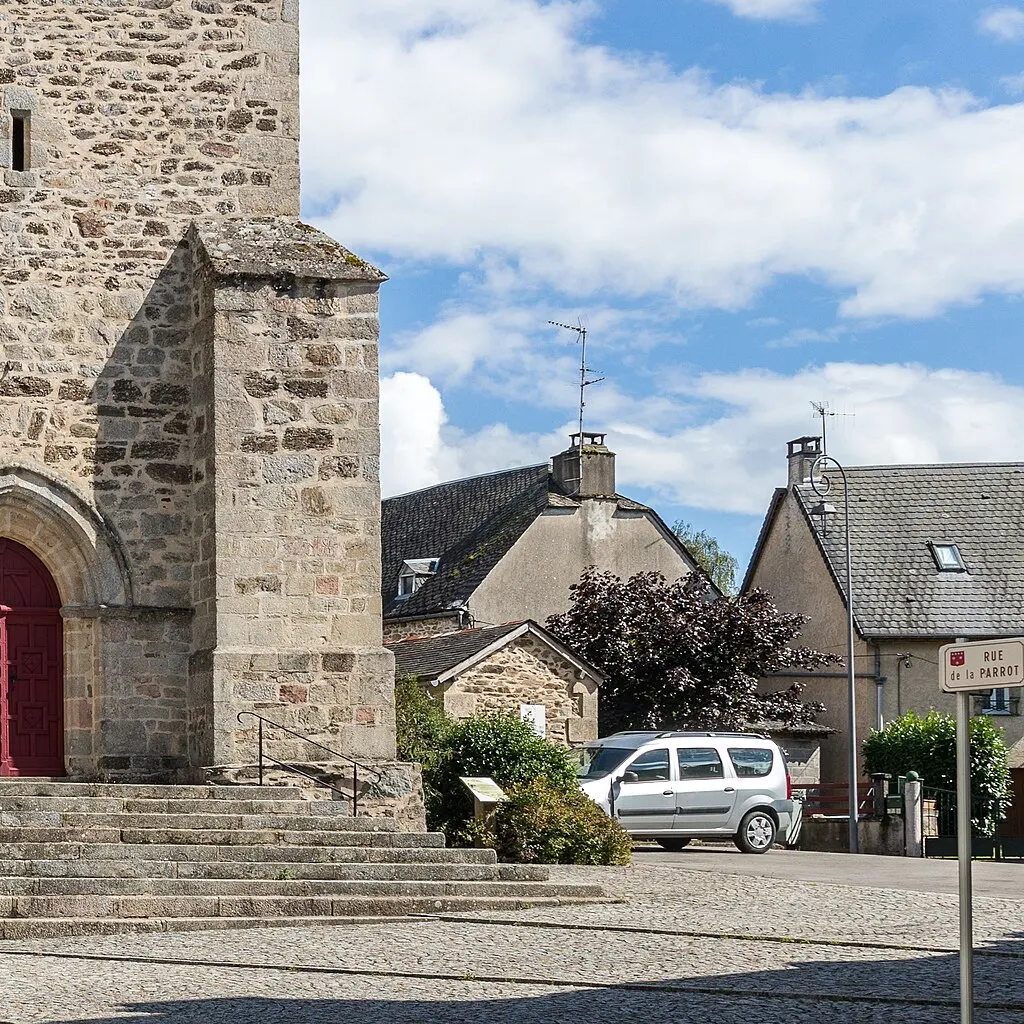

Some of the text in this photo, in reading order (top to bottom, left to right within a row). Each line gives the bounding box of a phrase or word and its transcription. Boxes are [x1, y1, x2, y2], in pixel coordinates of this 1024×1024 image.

[984, 650, 1004, 662] RUE
[950, 665, 1019, 681] de la PARROT
